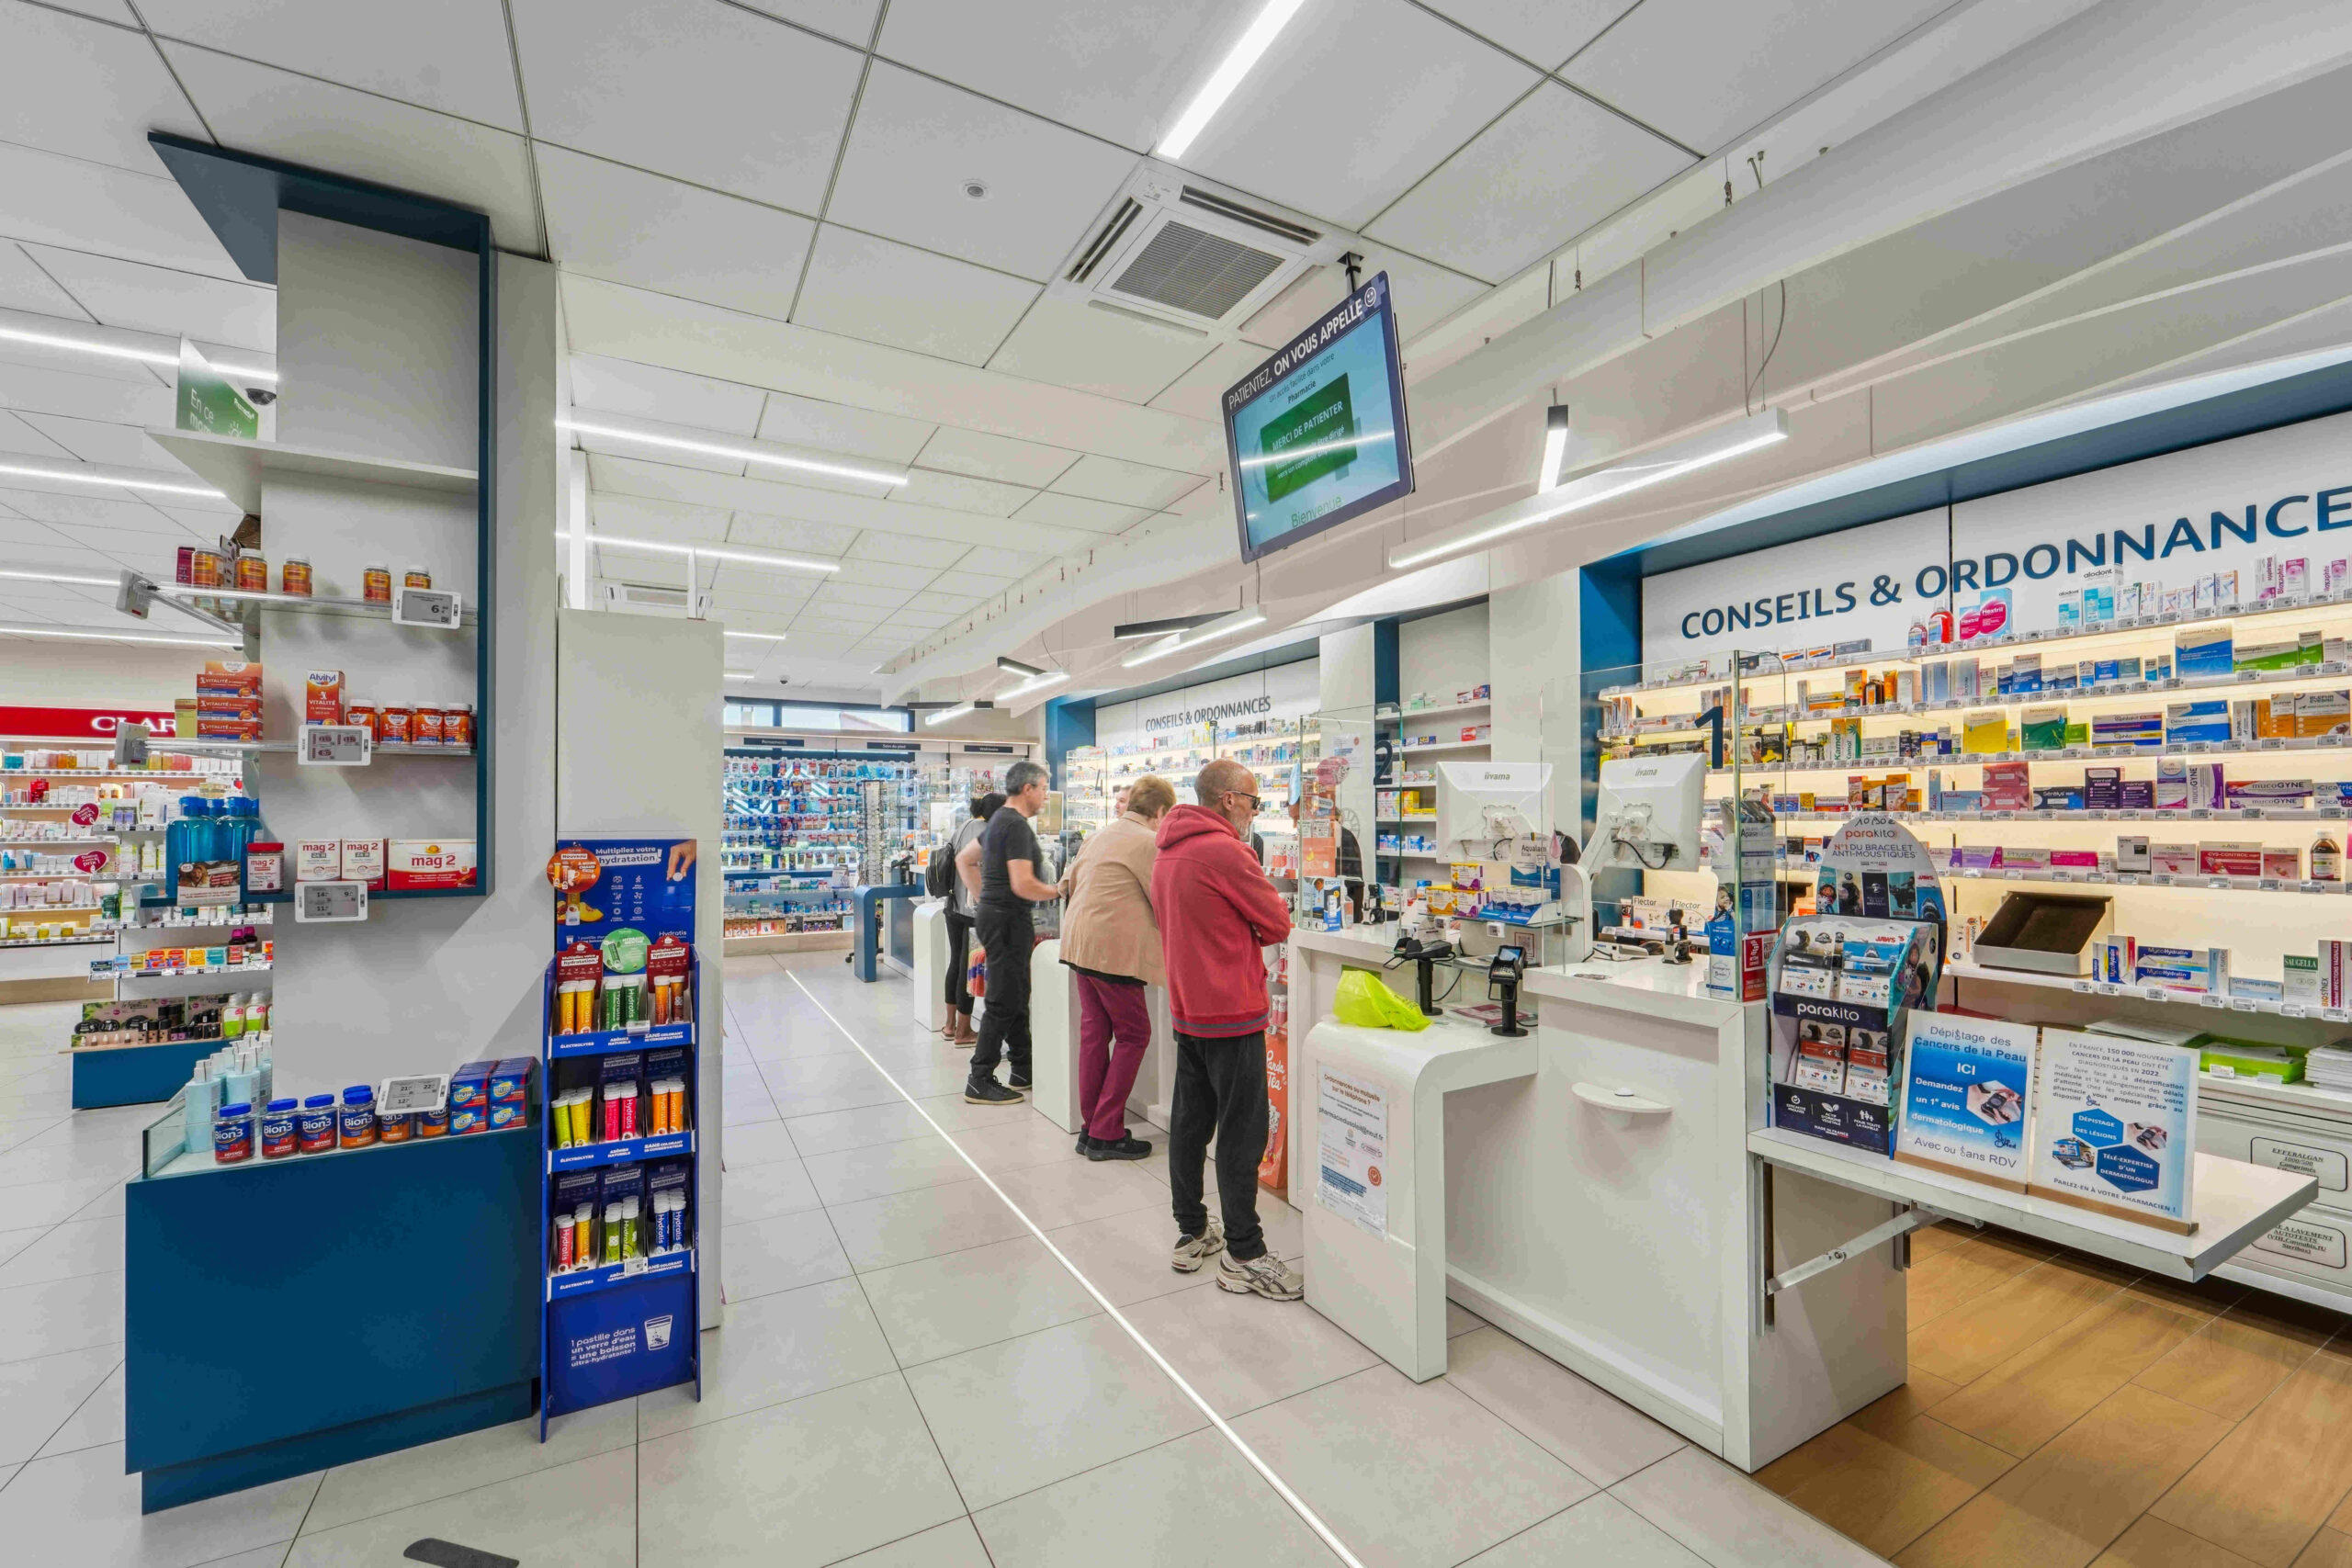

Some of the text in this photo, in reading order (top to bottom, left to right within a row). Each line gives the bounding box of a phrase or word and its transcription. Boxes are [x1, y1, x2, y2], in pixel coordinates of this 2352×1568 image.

[1228, 298, 1363, 410] PATIENTEZ, ON VOUS APPELLE
[1306, 353, 1335, 378] dans votre
[1287, 380, 1317, 404] Pharmacie
[191, 388, 214, 423] En ce
[1272, 400, 1343, 452] MERCI DE PATIENTER
[1291, 496, 1342, 528] Bienvenue
[2084, 568, 2112, 579] alodont
[1680, 581, 1858, 640] CONSEILS
[1871, 574, 1903, 606] &
[309, 672, 336, 682] Alvityl
[1145, 695, 1272, 732] CONSEILS & ORDONNANCES
[1693, 705, 1724, 770] 1
[1374, 740, 1394, 785] 2
[1484, 771, 1510, 781] iiyama
[1634, 767, 1658, 777] iiyama
[2189, 767, 2199, 804] mucoGYNE
[1845, 829, 1895, 840] parakito
[302, 842, 335, 852] mag 2
[346, 842, 379, 852] mag 2
[595, 847, 634, 856] Multipliez
[1832, 850, 1916, 859] ANTI-MOUSTIQUES
[411, 854, 456, 868] mag 2
[599, 854, 655, 864] hydratation
[1634, 897, 1657, 907] Flector
[1674, 900, 1702, 909] Flector
[2147, 947, 2188, 956] MycoHydralin
[2284, 958, 2316, 967] SAUGELLA
[2146, 968, 2187, 977] MycoHydralin
[1796, 1003, 1860, 1021] parakito
[1930, 1025, 2012, 1046] Dépistage des
[1914, 1036, 2027, 1063] Cancers de la Peau
[2078, 1043, 2106, 1053] FRANCE,
[2136, 1053, 2175, 1063] NOUVEAUX
[1266, 1050, 1285, 1074] Panda
[2072, 1051, 2100, 1060] CANCERS
[2122, 1057, 2140, 1066] PEAU
[2077, 1059, 2129, 1073] DIAGNOSTIQUÉS
[1957, 1062, 1976, 1076] ICI
[1267, 1071, 1282, 1090] Tea
[1915, 1077, 1963, 1093] Demandez
[2054, 1072, 2184, 1098] médicale rallongement des délais
[2074, 1066, 2088, 1074] faire
[2133, 1077, 2185, 1090] désertification
[2052, 1091, 2082, 1101] dispositif
[2053, 1077, 2083, 1088] d'attente
[2120, 1089, 2159, 1101] spécialistes,
[1915, 1096, 1961, 1111] un avis
[2052, 1085, 2086, 1095] pharmacie
[2113, 1096, 2142, 1106] propose
[2148, 1102, 2167, 1111] grâce
[302, 1118, 332, 1130] Bion3
[345, 1112, 373, 1126] Bion3
[1911, 1111, 1984, 1134] dermatologique
[2078, 1114, 2115, 1128] DÉPISTAGE
[215, 1128, 243, 1140] Bion3
[264, 1122, 293, 1134] Bion3
[2075, 1127, 2118, 1141] DES LÉSIONS
[1914, 1136, 2018, 1168] Avec ou Sans RDV
[2272, 1147, 2324, 1162] EFFERALGAN
[2102, 1152, 2154, 1168] TÉLÉ-EXPERTISE
[2279, 1161, 2316, 1173] Comprimés
[2099, 1168, 2154, 1185] DERMATOLOGUE
[2118, 1165, 2136, 1173] D'UN
[2053, 1178, 2171, 1212] PARLEZ-EN À VOTRE PHARMACIEN
[2273, 1229, 2318, 1244] AUTOTESTS
[2290, 1226, 2334, 1242] LAVEMENT
[576, 1327, 636, 1348] pastille dans
[585, 1341, 609, 1350] verre
[611, 1335, 636, 1345] d'eau
[571, 1348, 632, 1367] ultra-hydratante
[579, 1341, 636, 1359] une boisson
